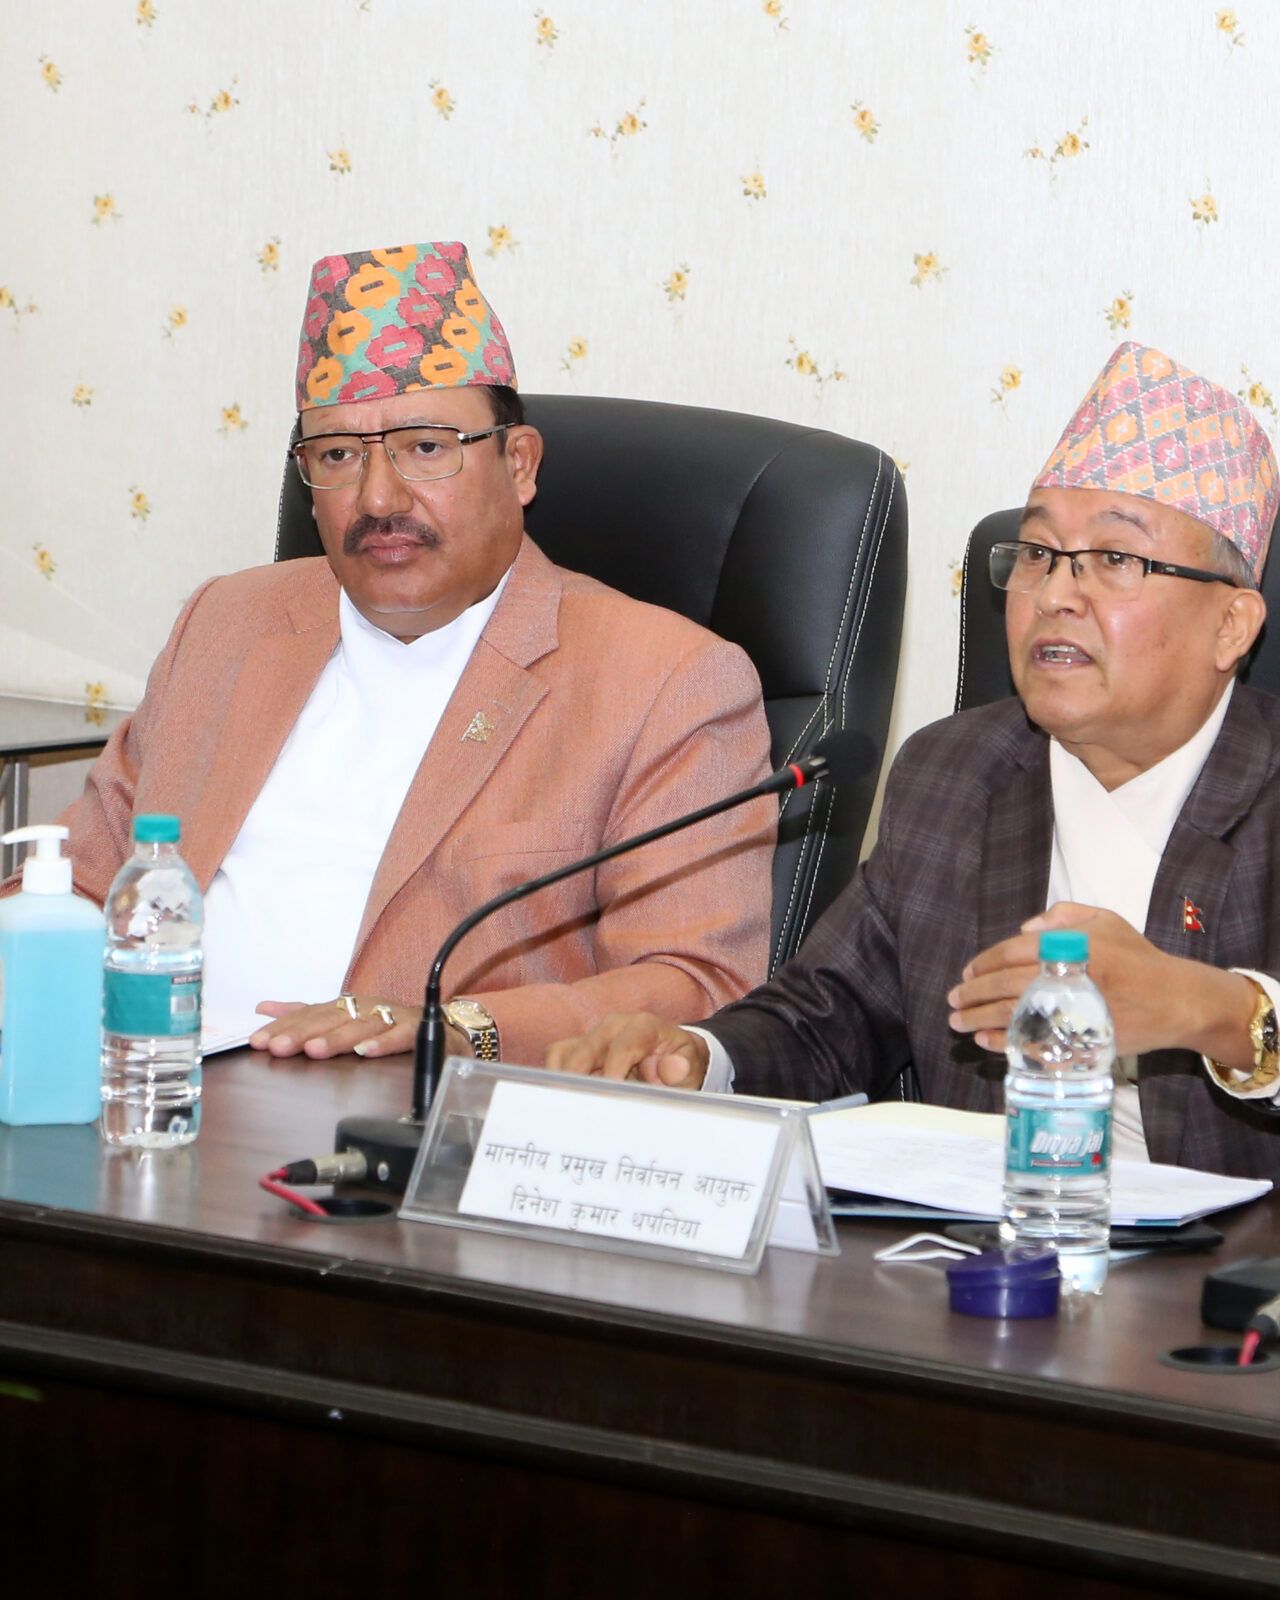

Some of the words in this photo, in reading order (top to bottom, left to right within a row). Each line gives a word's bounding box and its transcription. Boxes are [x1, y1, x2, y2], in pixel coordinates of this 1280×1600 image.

[485, 1141, 551, 1170] माननीय
[560, 1154, 608, 1185] प्रमुख
[616, 1155, 684, 1190] निर्वाचन
[694, 1175, 757, 1207] आयुक्त
[510, 1184, 561, 1217] दिनेश
[568, 1202, 622, 1230] कुमार
